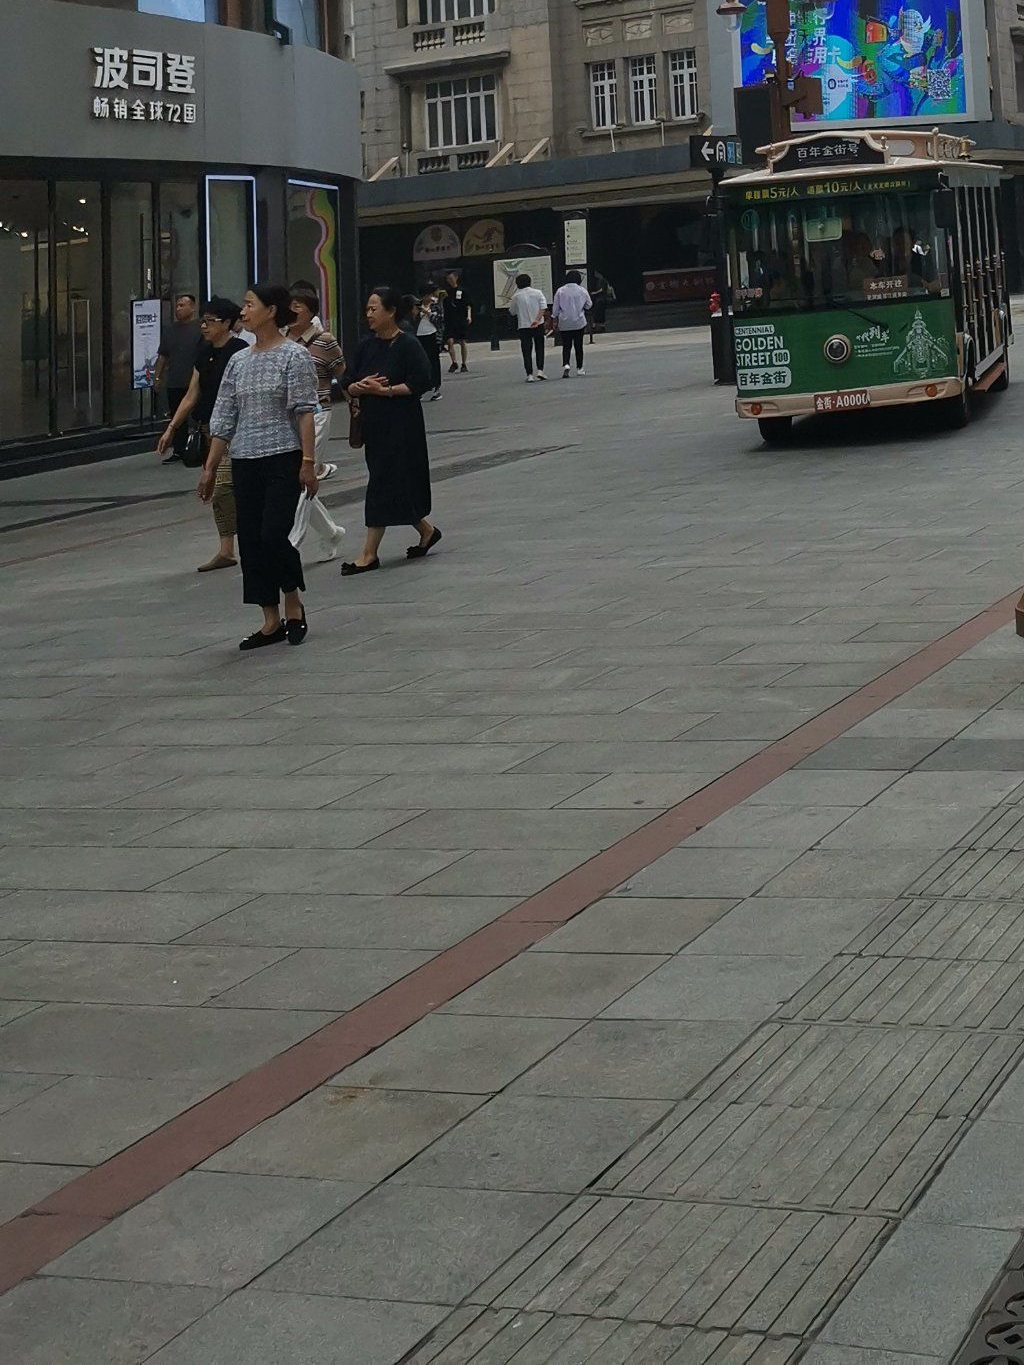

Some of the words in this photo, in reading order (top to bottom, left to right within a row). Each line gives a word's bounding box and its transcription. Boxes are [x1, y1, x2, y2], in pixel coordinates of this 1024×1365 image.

[93, 46, 196, 94] 波司登
[93, 96, 197, 124] 畅销全球72国
[796, 144, 860, 160] 百年金街号
[735, 336, 784, 352] GOLDEN
[736, 353, 770, 367] STREET
[774, 353, 788, 364] 100
[738, 372, 788, 387] 百年金街
